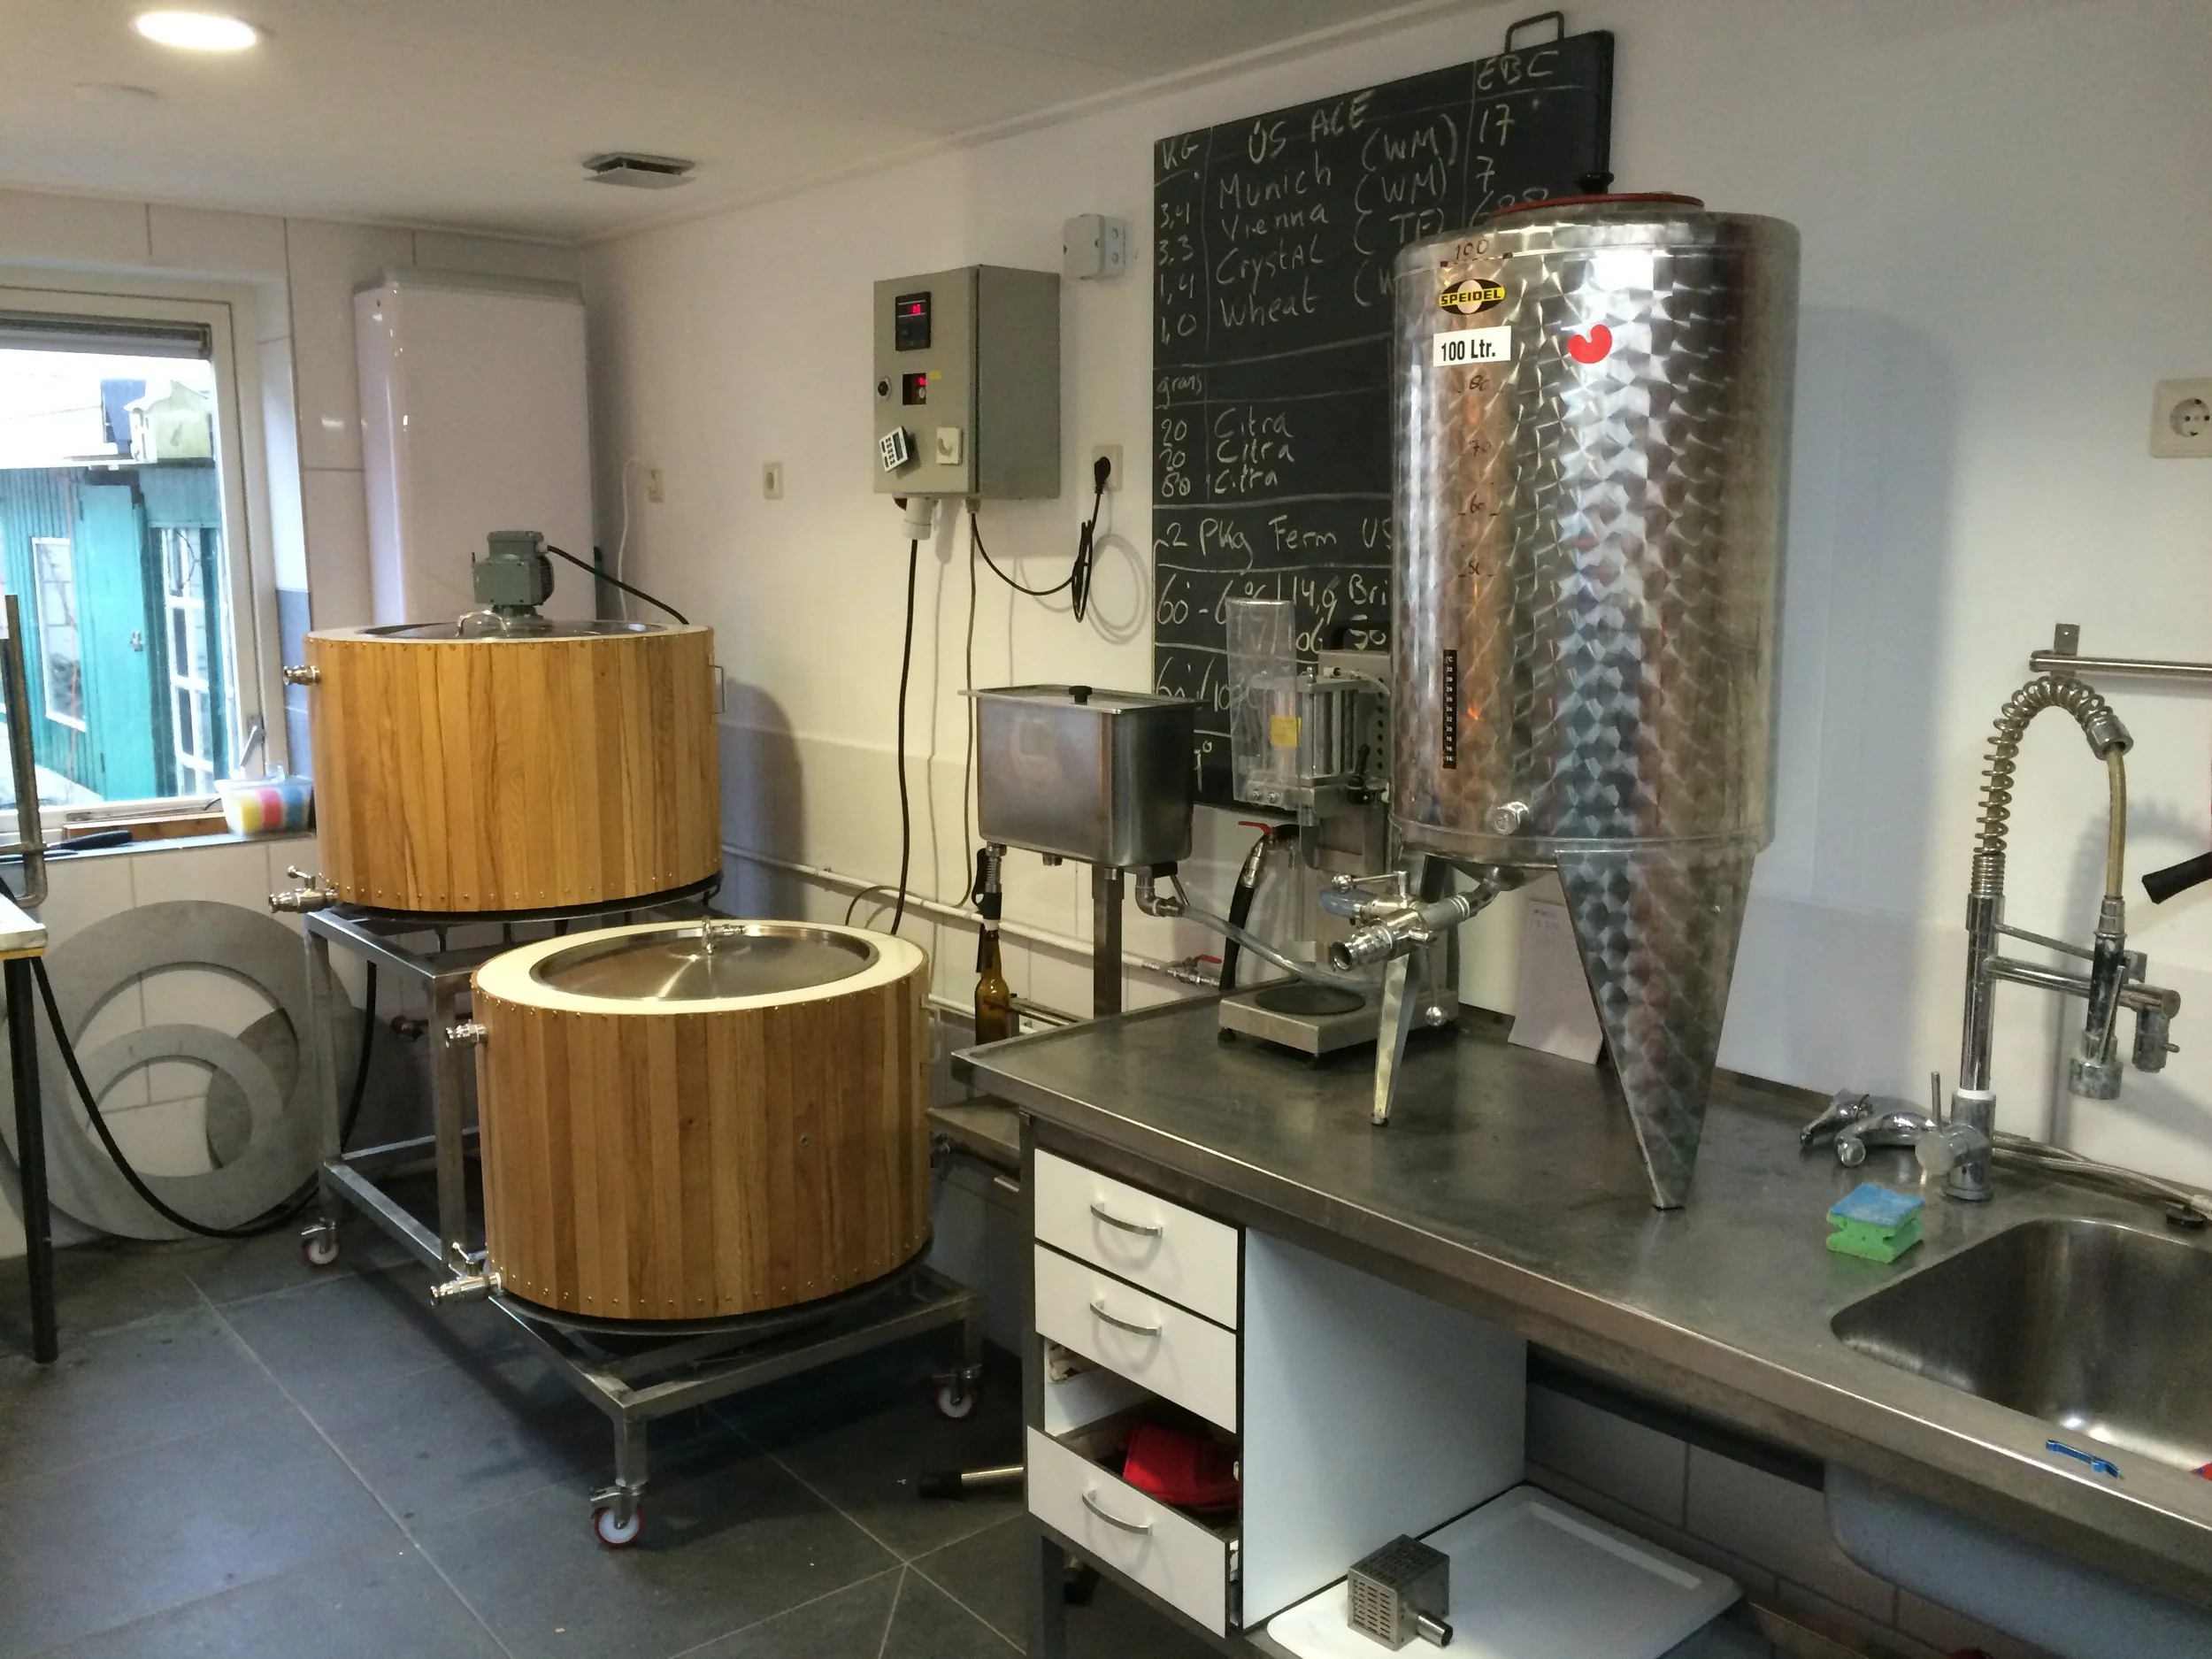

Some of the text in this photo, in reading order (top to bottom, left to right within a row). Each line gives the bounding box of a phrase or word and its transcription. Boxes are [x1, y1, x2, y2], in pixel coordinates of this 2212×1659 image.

[1477, 50, 1559, 89] EBC
[1479, 104, 1516, 146] 17
[1163, 134, 1199, 170] KG
[1219, 150, 1332, 209] Munich
[1476, 156, 1495, 192] 7
[1221, 204, 1329, 242] Vienna
[1159, 234, 1194, 265] 3,3
[1454, 239, 1489, 259] 100
[1220, 275, 1319, 327] Wheat
[1440, 288, 1502, 305] SPEIDEL
[1441, 339, 1495, 362] 100 Ltr.
[1161, 406, 1294, 447] 20 Citra
[1217, 439, 1295, 464] Citra
[1215, 464, 1278, 495] Citra
[1269, 514, 1337, 551] Ferm
